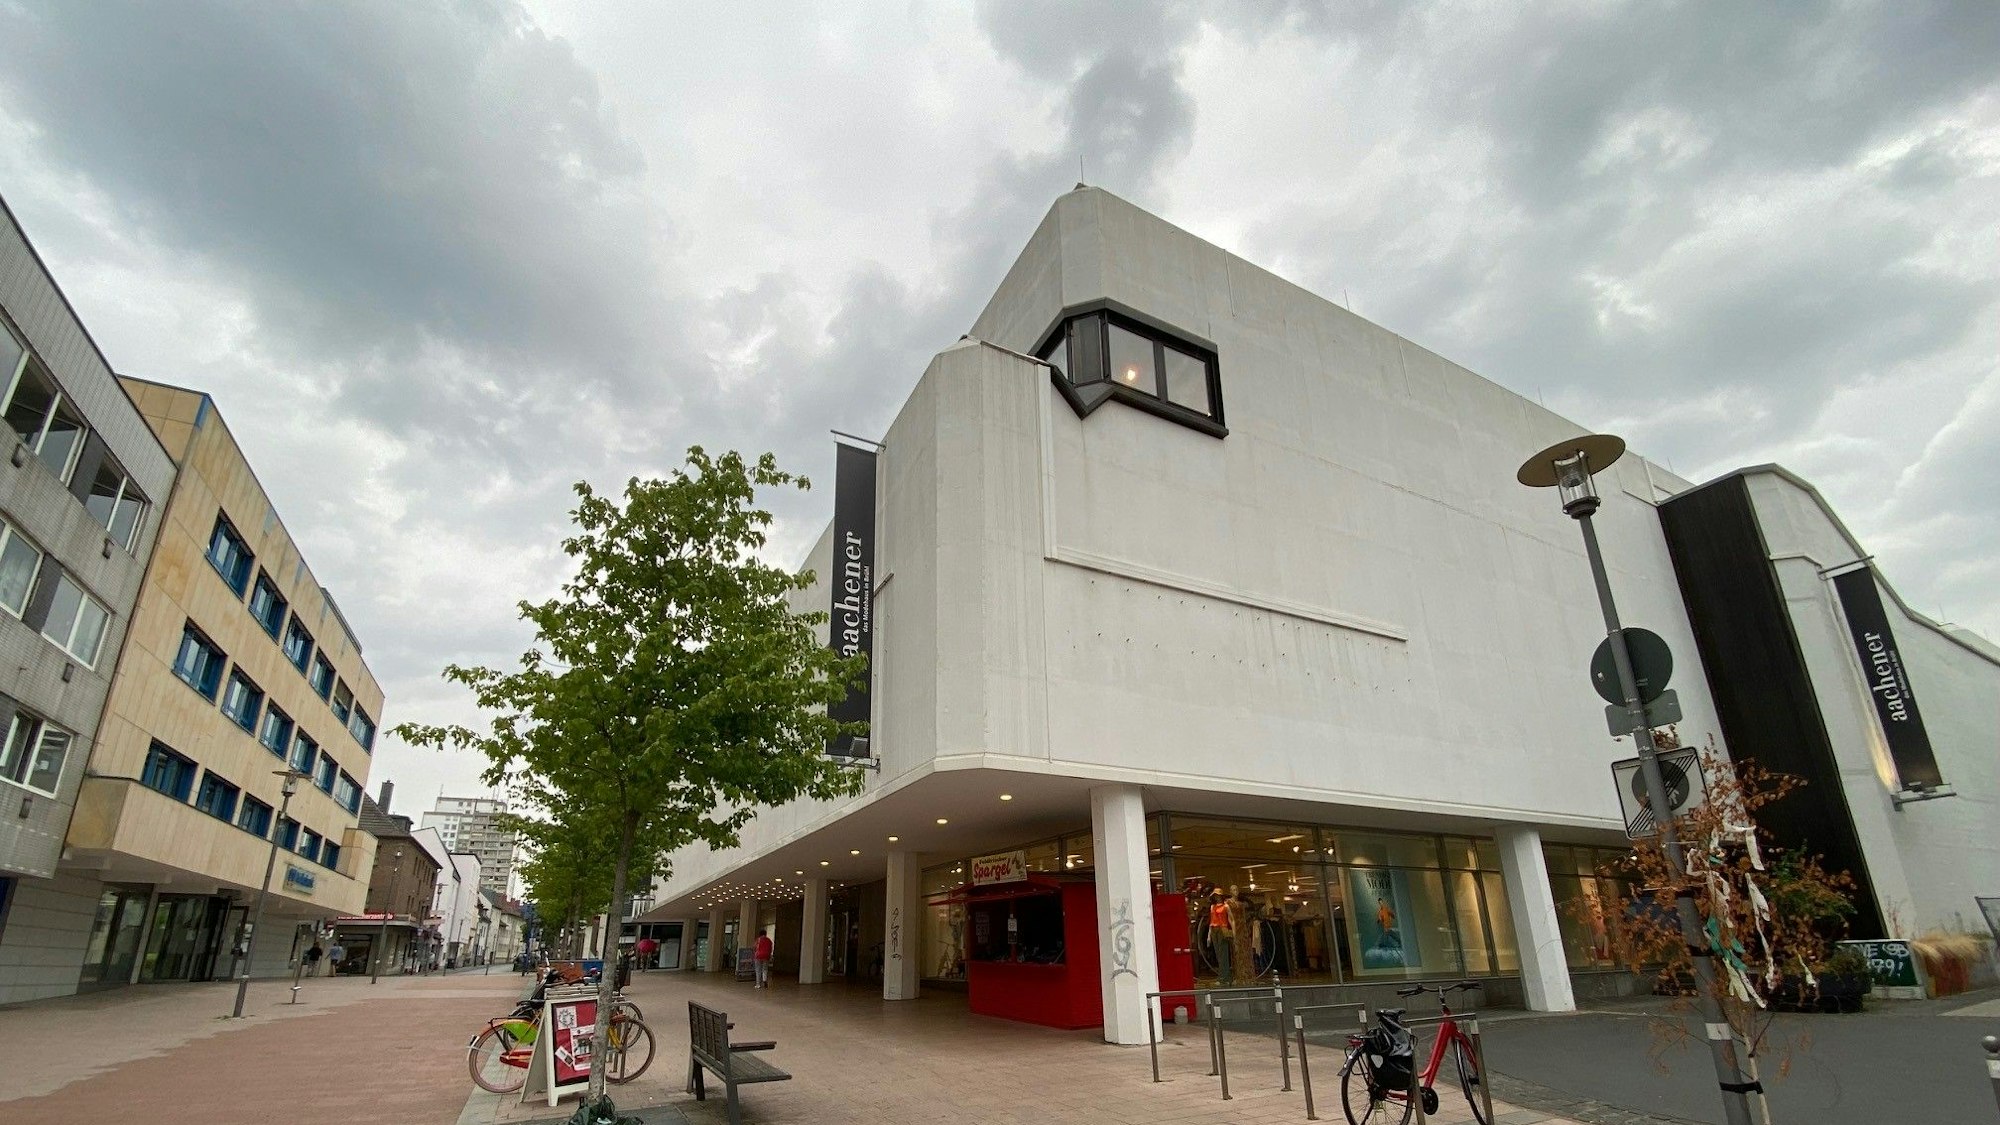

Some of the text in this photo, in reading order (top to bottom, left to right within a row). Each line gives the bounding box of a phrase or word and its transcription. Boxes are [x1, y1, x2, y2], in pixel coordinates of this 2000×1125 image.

[834, 531, 862, 658] aachener
[1864, 632, 1908, 721] aachener
[973, 858, 1011, 883] Spargel
